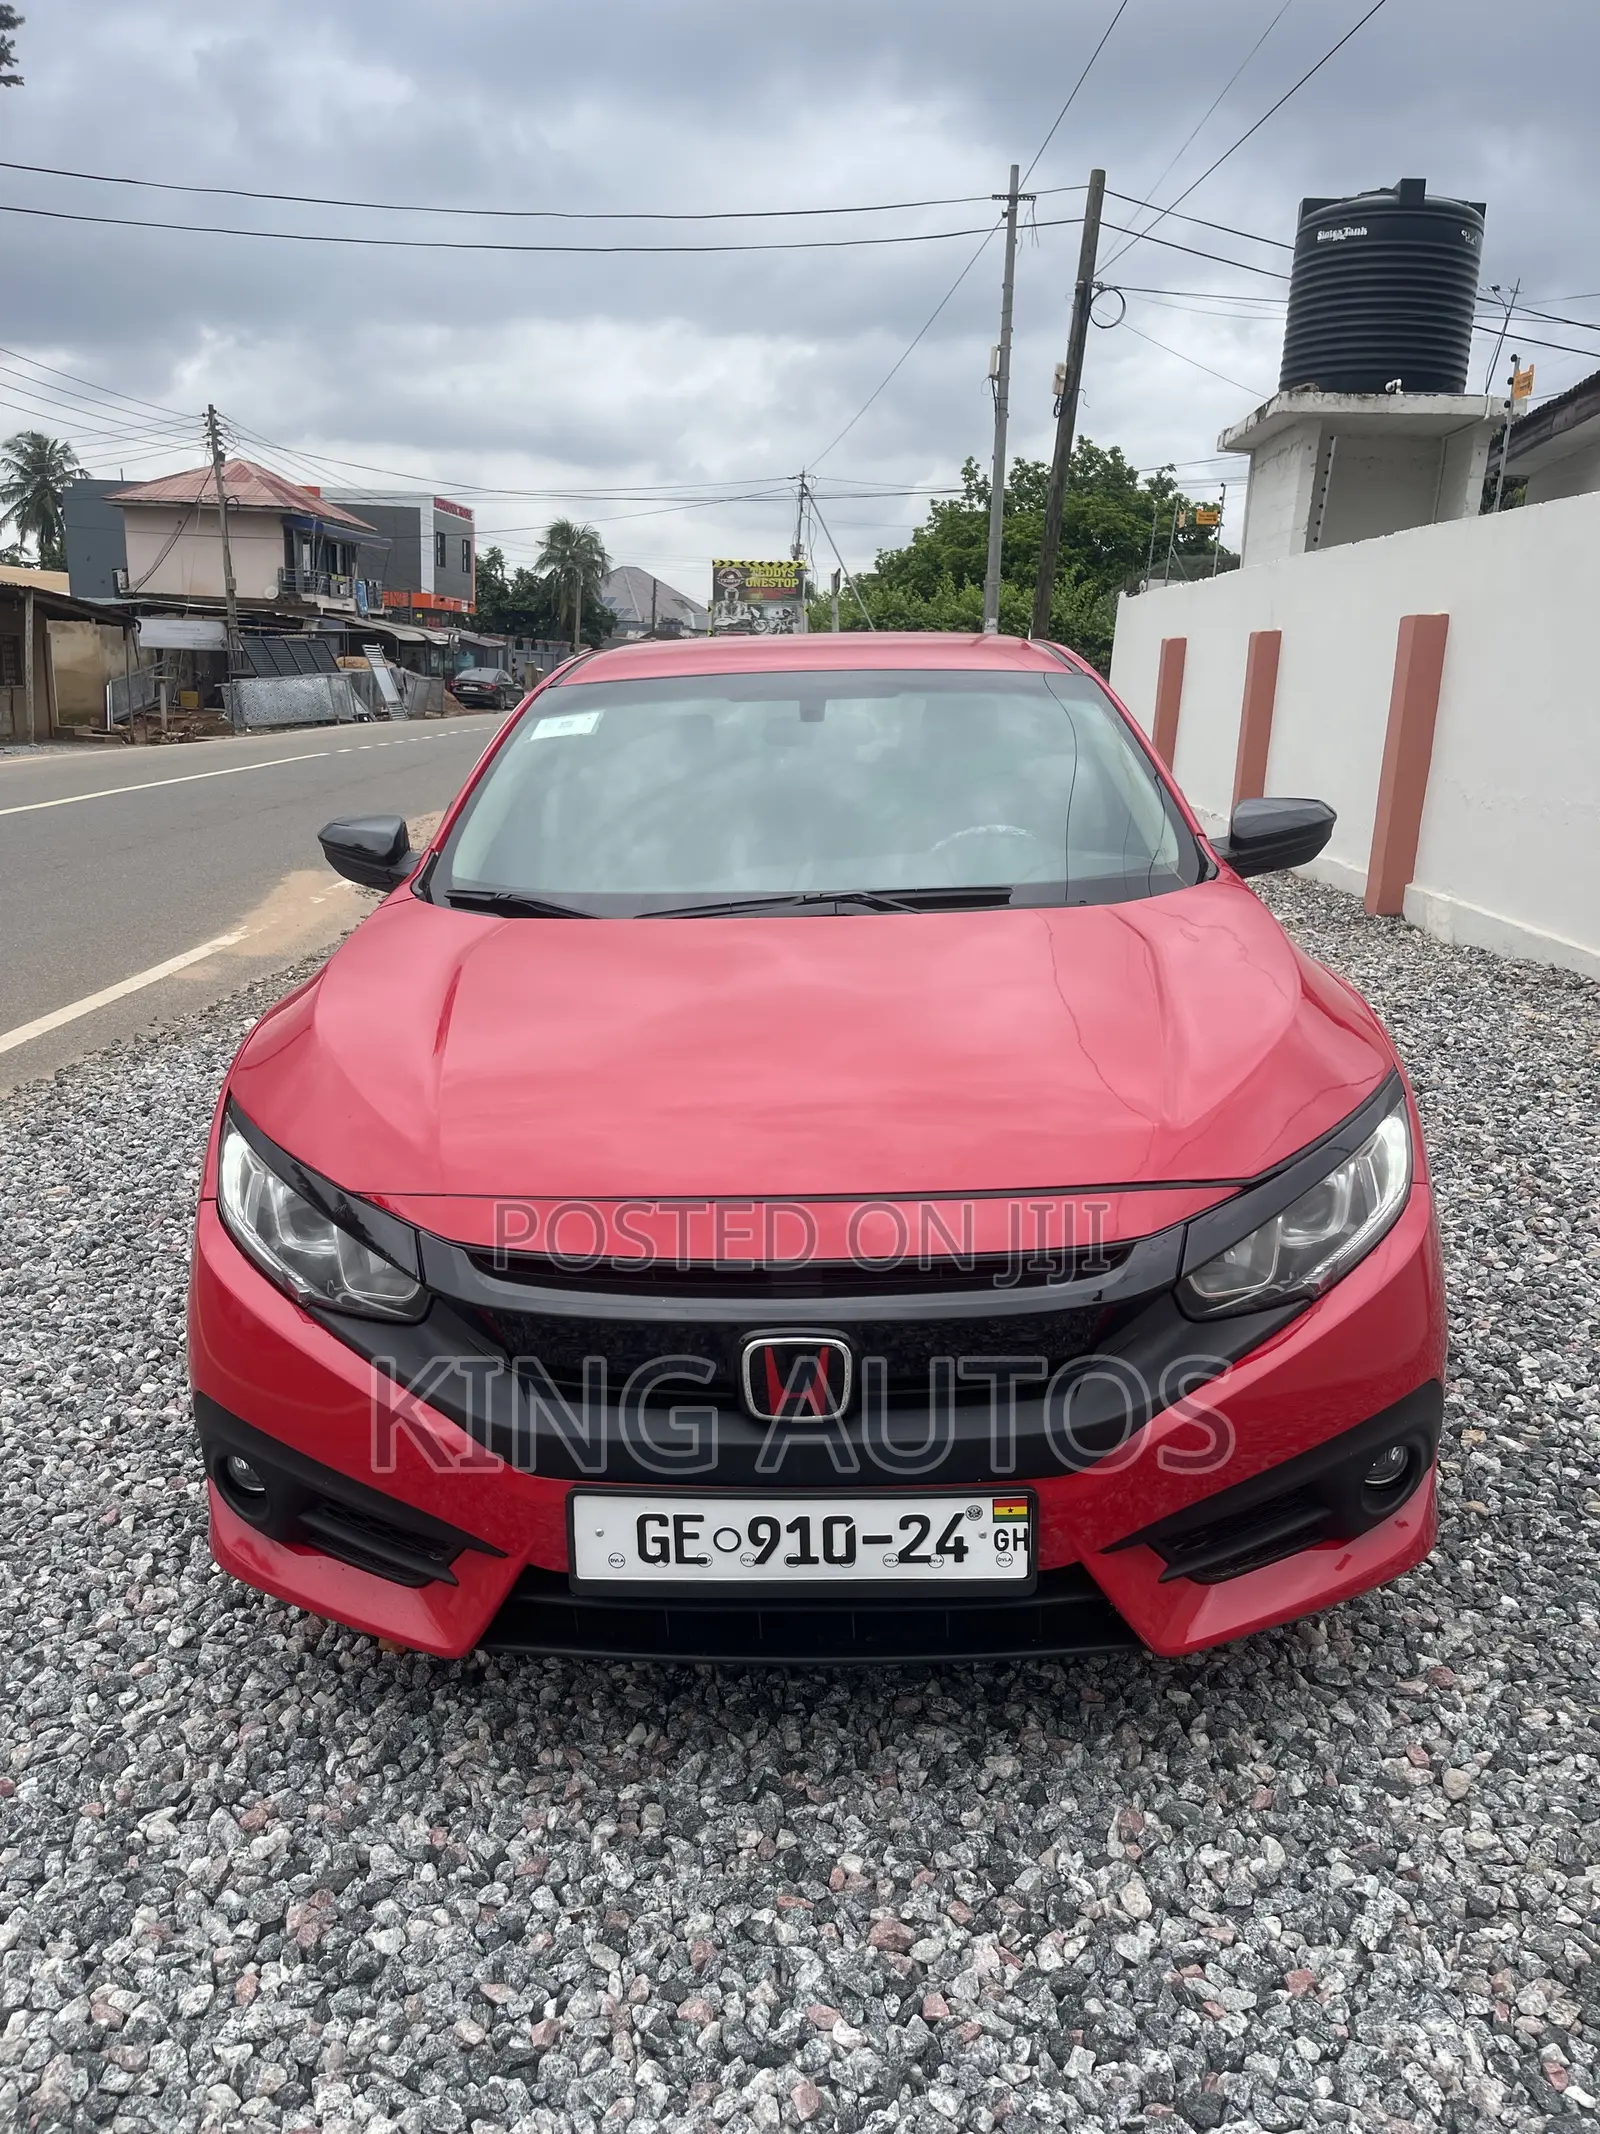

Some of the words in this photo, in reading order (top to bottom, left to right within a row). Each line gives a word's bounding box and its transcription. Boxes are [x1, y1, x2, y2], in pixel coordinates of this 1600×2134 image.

[750, 567, 795, 577] TEDDYS
[745, 578, 799, 588] ONESTOP
[993, 1528, 1028, 1551] GH
